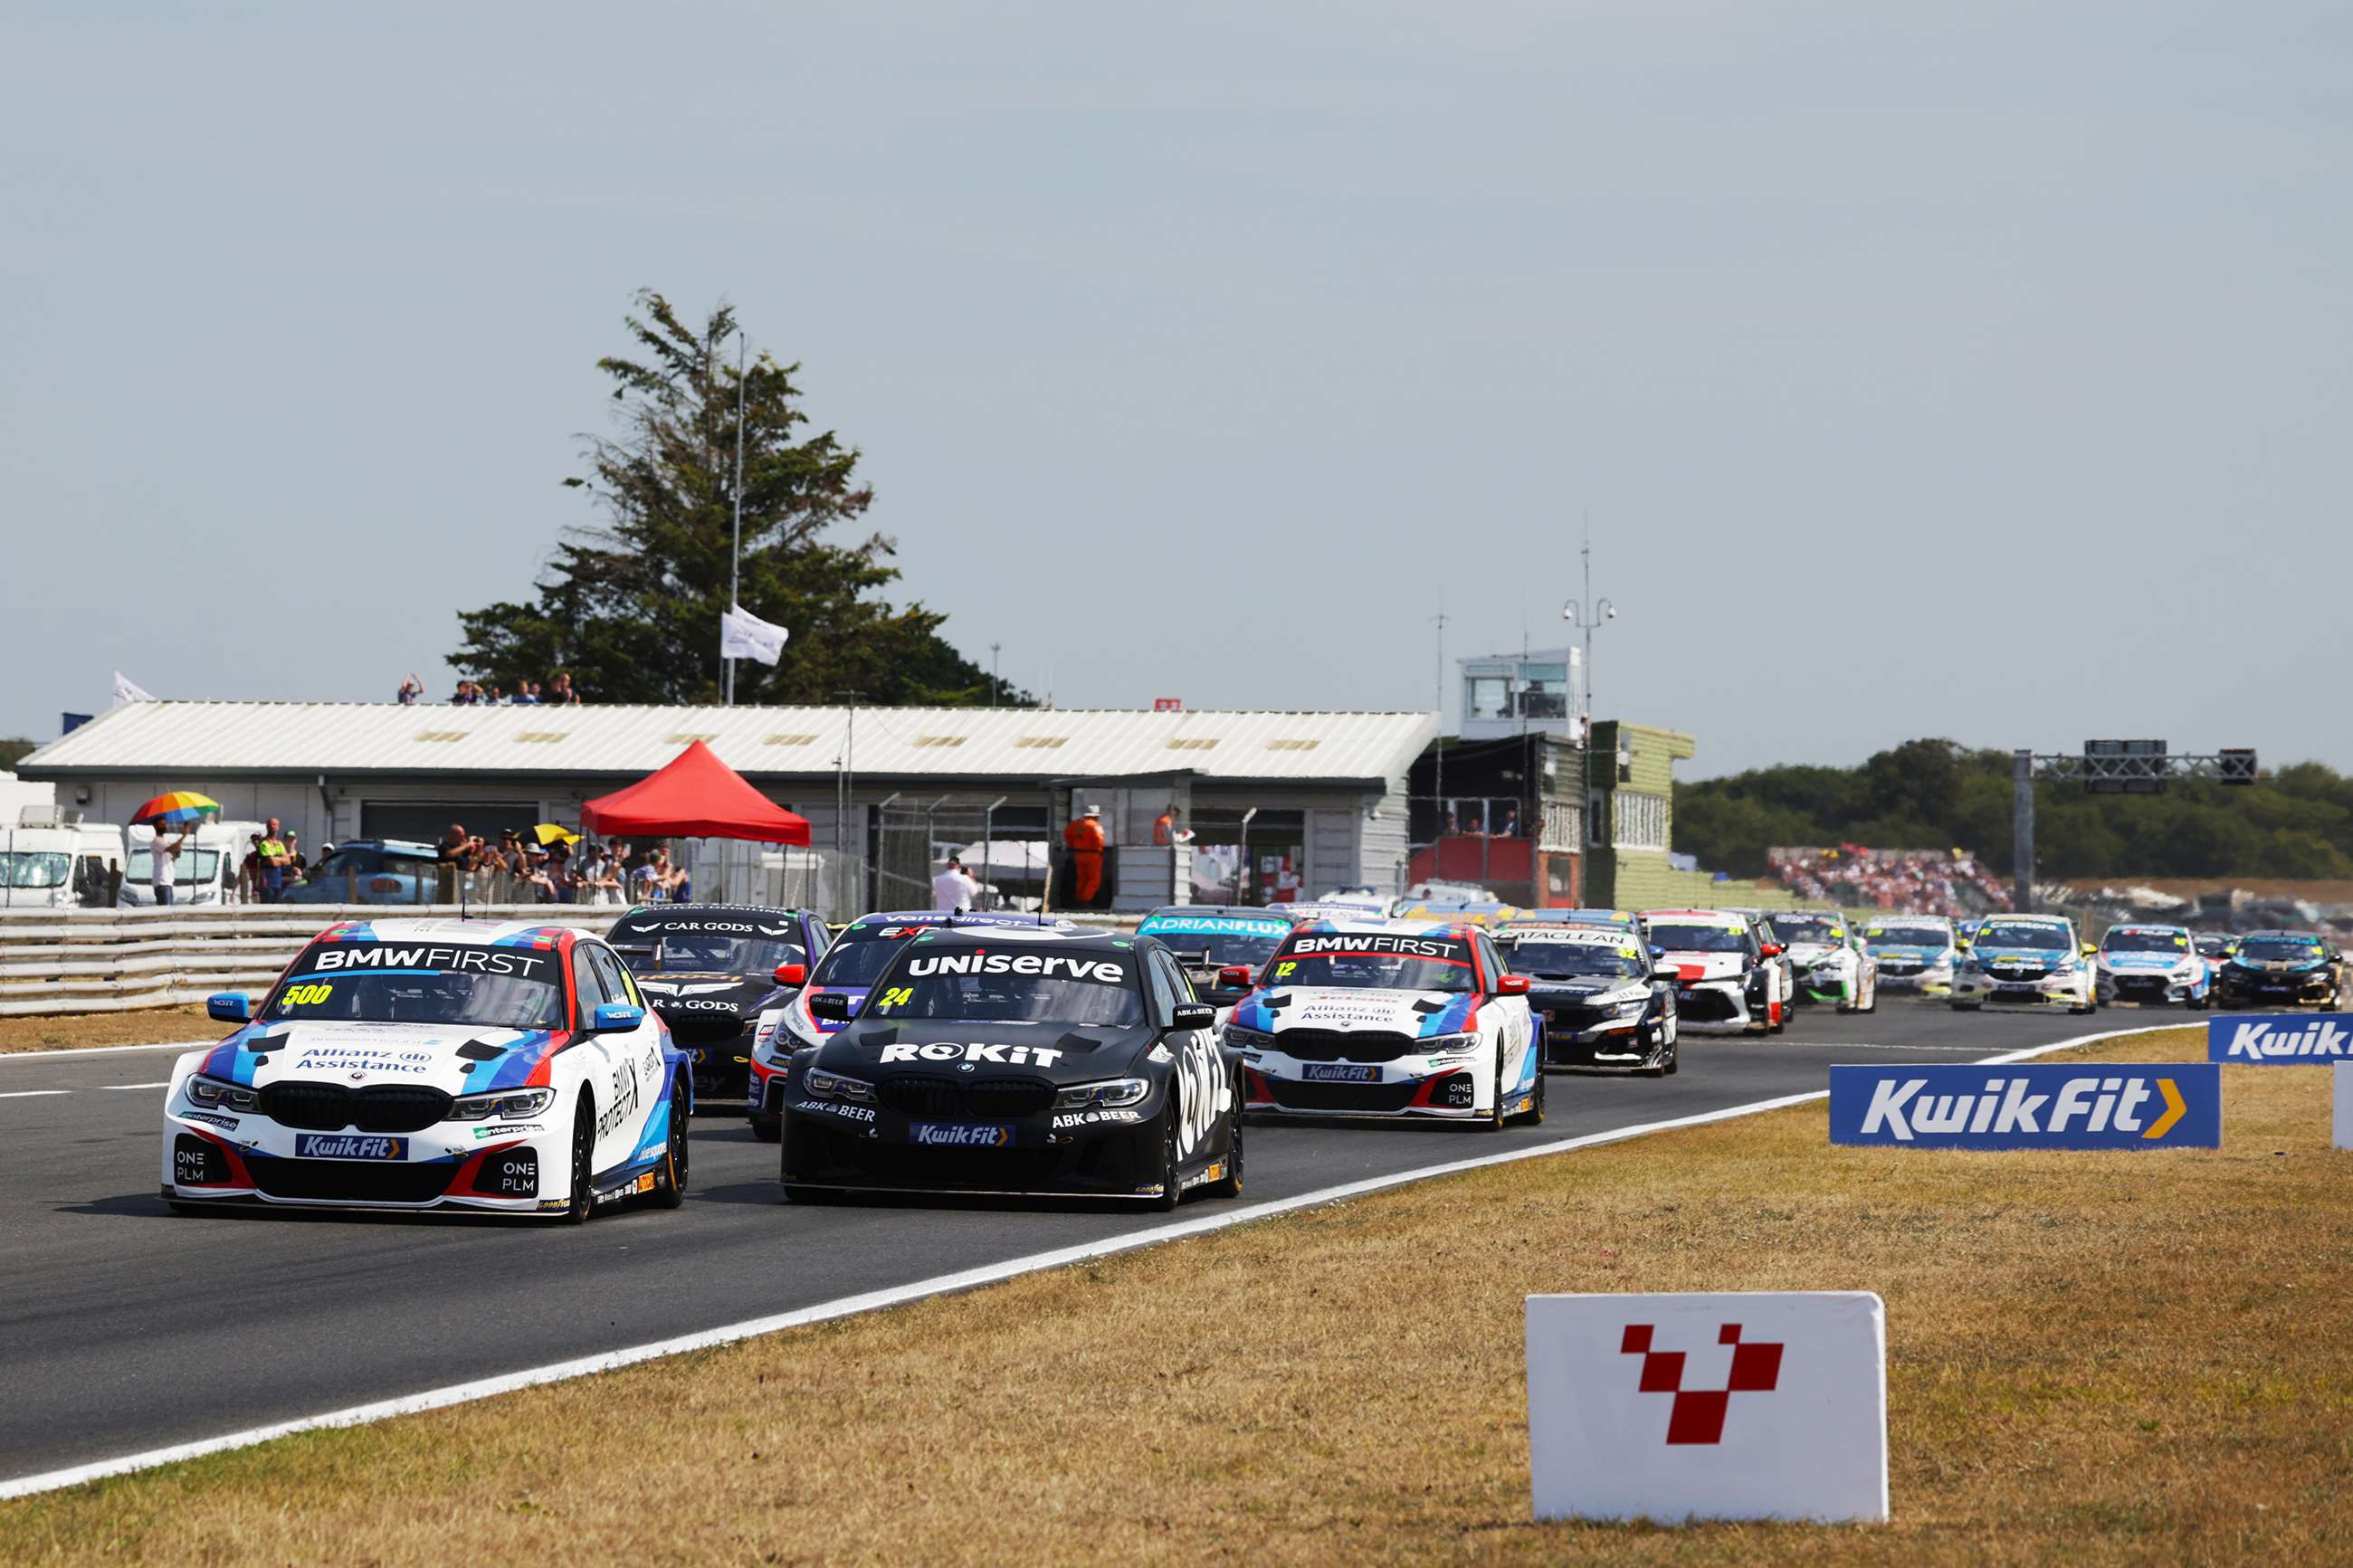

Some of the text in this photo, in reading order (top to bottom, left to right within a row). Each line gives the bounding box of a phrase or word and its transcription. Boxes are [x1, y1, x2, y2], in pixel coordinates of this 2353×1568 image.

[664, 922, 754, 932] CAR GODS
[1142, 919, 1290, 935] ADRIANFLUX
[1274, 962, 1297, 977] 12
[281, 984, 333, 1006] 500
[828, 998, 844, 1006] BEER
[878, 987, 914, 1006] 24
[685, 1000, 739, 1012] GODS
[1176, 1009, 1192, 1017] ABK
[1301, 1012, 1394, 1022] Assistance
[2228, 1021, 2353, 1060] Kwik
[301, 1048, 393, 1059] Allianz
[295, 1059, 426, 1074] Assistance
[1449, 1083, 1472, 1093] ONE
[1449, 1095, 1471, 1105] PLM
[796, 1099, 876, 1123] ABK BEER
[183, 1111, 237, 1129] enterprise
[1053, 1110, 1143, 1129] ABK BEER
[176, 1151, 205, 1165] ONE
[177, 1166, 204, 1181] PLM
[503, 1162, 536, 1175] ONE
[502, 1178, 535, 1192] PLM
